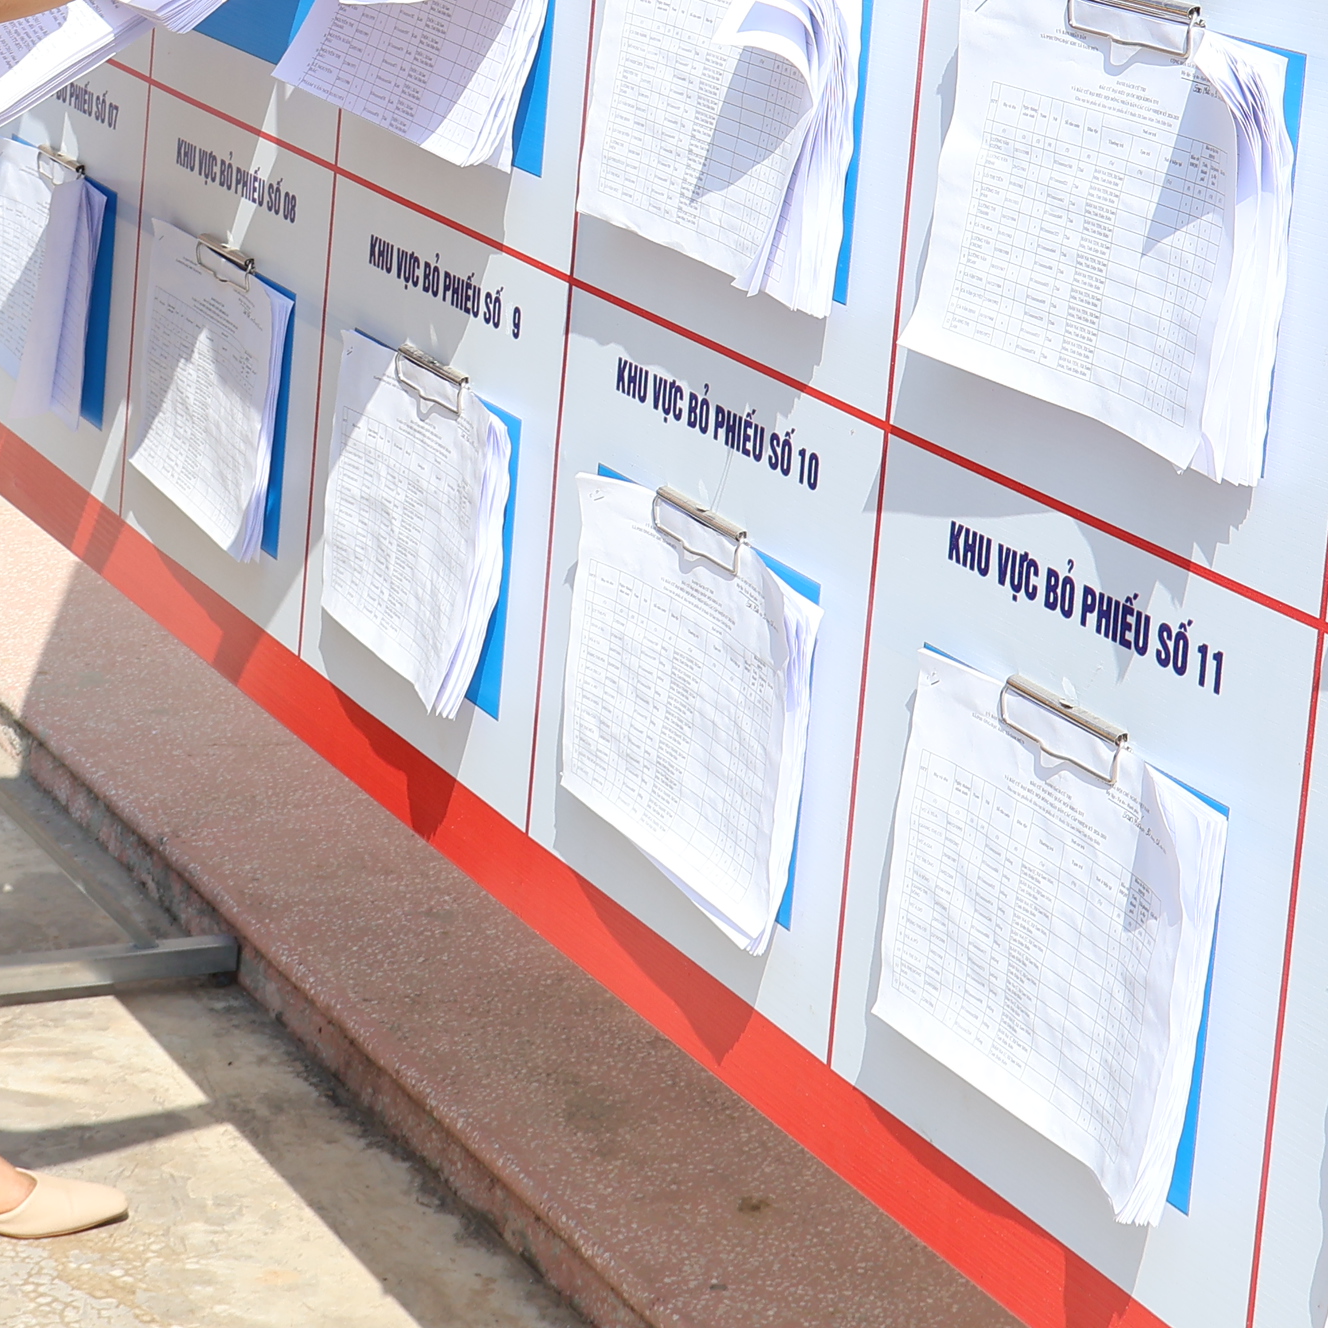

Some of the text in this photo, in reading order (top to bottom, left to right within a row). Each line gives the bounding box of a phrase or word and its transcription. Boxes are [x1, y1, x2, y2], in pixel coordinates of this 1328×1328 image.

[69, 81, 94, 118] PHIẾU
[95, 90, 108, 124] SỐ
[108, 102, 119, 130] 07
[176, 138, 296, 223] KHU VỰC BỎ PHIẾU SỐ 08
[369, 234, 521, 339] KHU VỰC BỎ PHIẾU SỐ 9
[616, 357, 819, 490] KHU VỰC BỎ PHIẾU SỐ 10
[948, 521, 1223, 695] KHU VỰC BỎ PHIẾU SỐ 11
